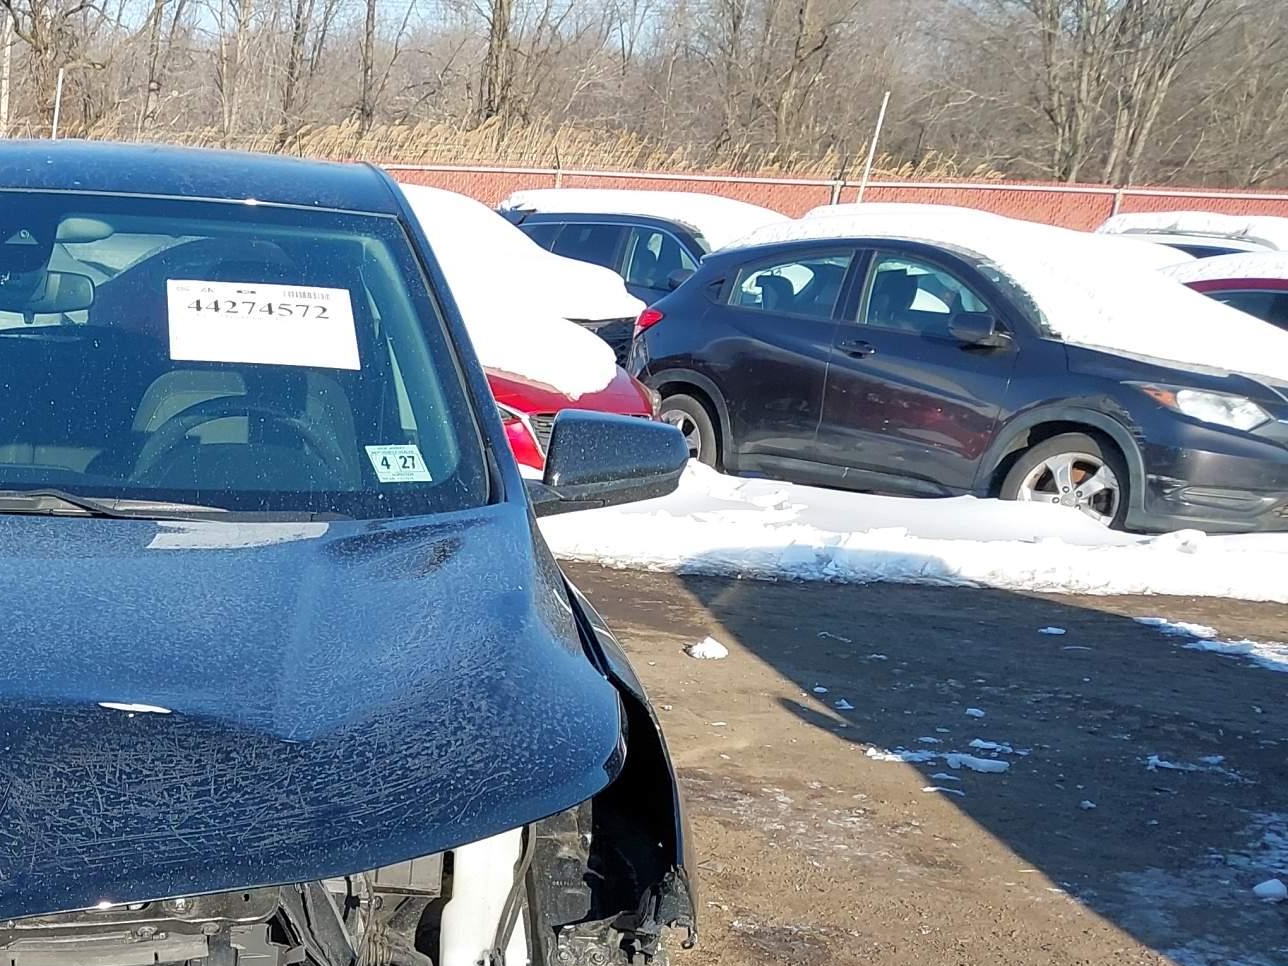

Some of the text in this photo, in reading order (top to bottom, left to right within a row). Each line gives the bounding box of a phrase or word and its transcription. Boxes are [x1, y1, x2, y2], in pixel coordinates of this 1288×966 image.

[187, 299, 330, 319] 44274572
[380, 455, 416, 470] 4 27
